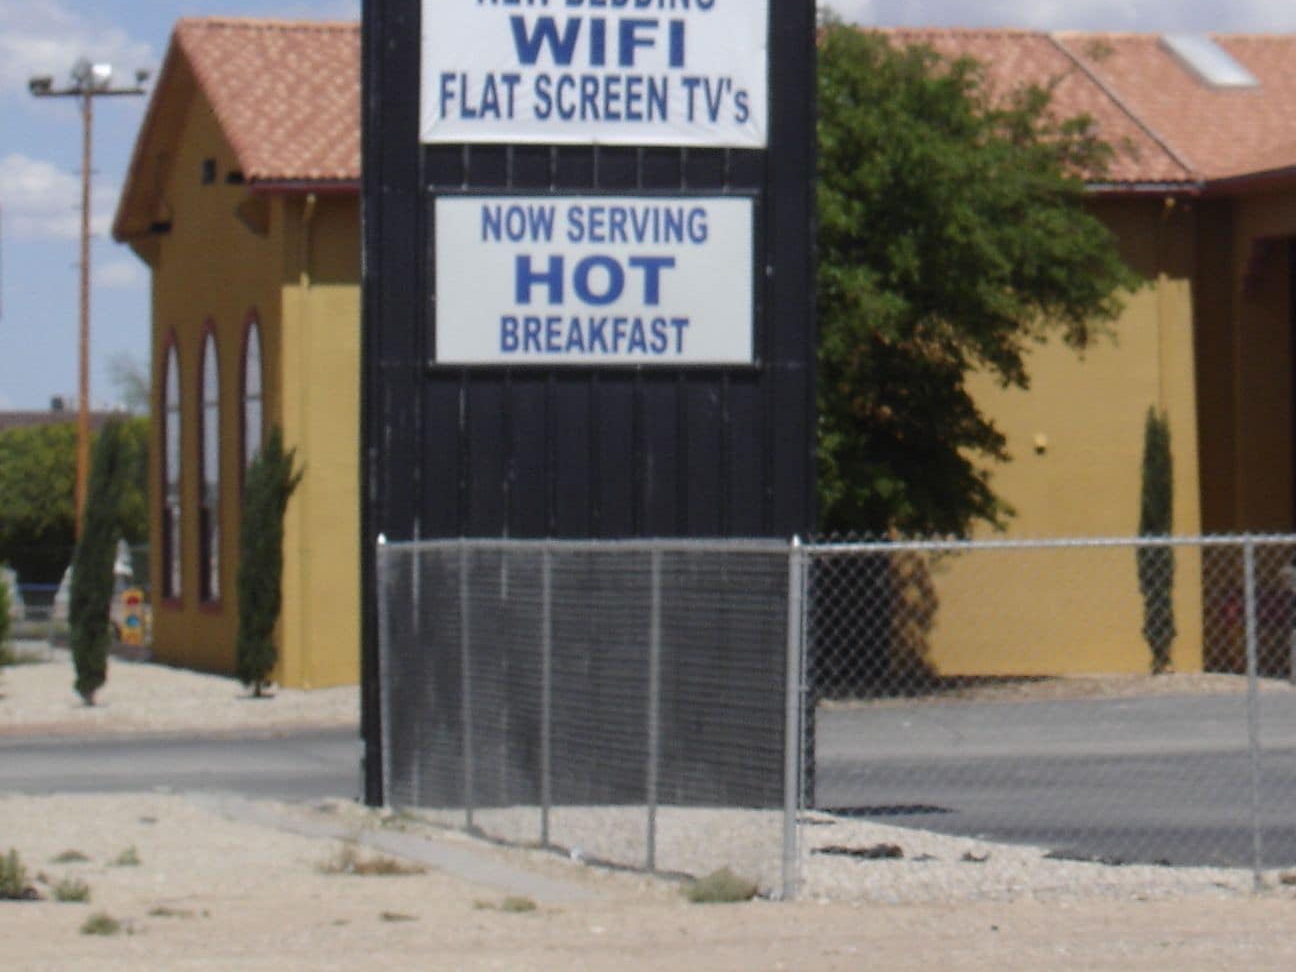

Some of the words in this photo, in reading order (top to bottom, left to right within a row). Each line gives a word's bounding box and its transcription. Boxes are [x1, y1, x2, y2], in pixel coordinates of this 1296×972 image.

[509, 15, 686, 69] WIFI
[440, 73, 521, 120] FLAT
[533, 74, 668, 122] SCREEN
[682, 77, 750, 124] TV's
[481, 205, 556, 242] NOW
[567, 206, 709, 244] SERVING
[514, 254, 676, 306] HOT
[500, 316, 690, 355] BREAKFAST
